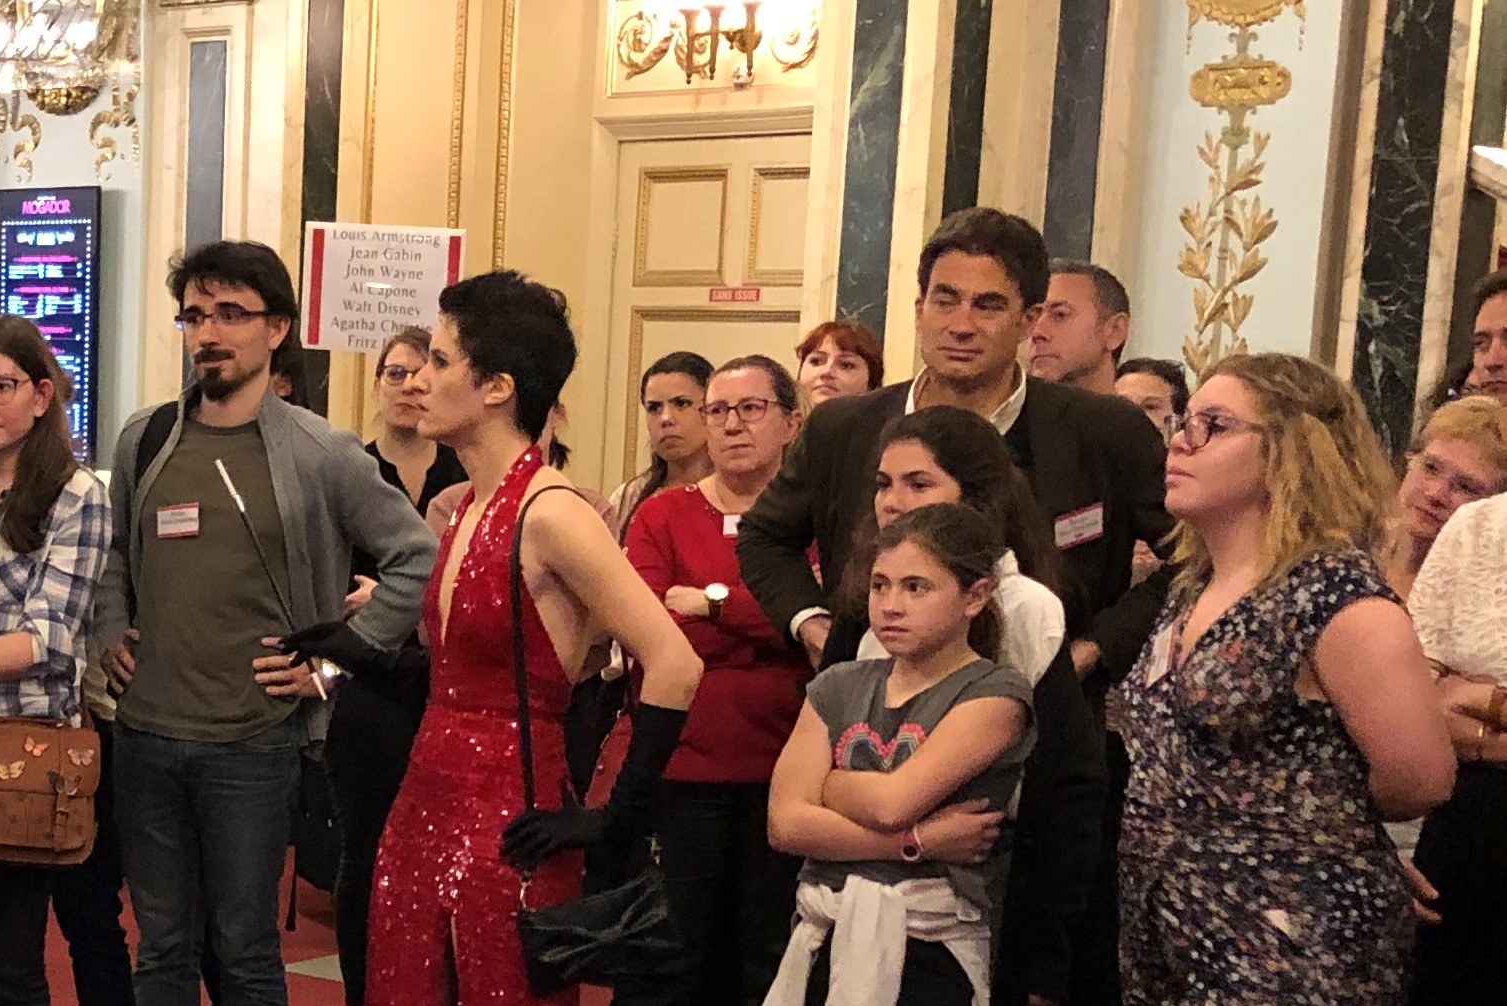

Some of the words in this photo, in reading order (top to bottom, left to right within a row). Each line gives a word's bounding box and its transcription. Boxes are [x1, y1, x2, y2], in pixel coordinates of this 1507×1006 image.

[21, 200, 71, 215] MOGADOR
[333, 229, 367, 241] Louis
[372, 231, 441, 248] Armstrong
[348, 246, 379, 262] Jean
[383, 248, 422, 262] Gabin
[343, 264, 375, 279] John
[380, 265, 424, 281] Wayne
[349, 282, 363, 294] Al
[367, 284, 417, 299] Capone
[342, 300, 372, 313] Walt
[377, 301, 421, 317] Disney
[330, 316, 375, 332] Agatha
[381, 319, 432, 333] Chritie
[348, 334, 377, 349] Fritz
